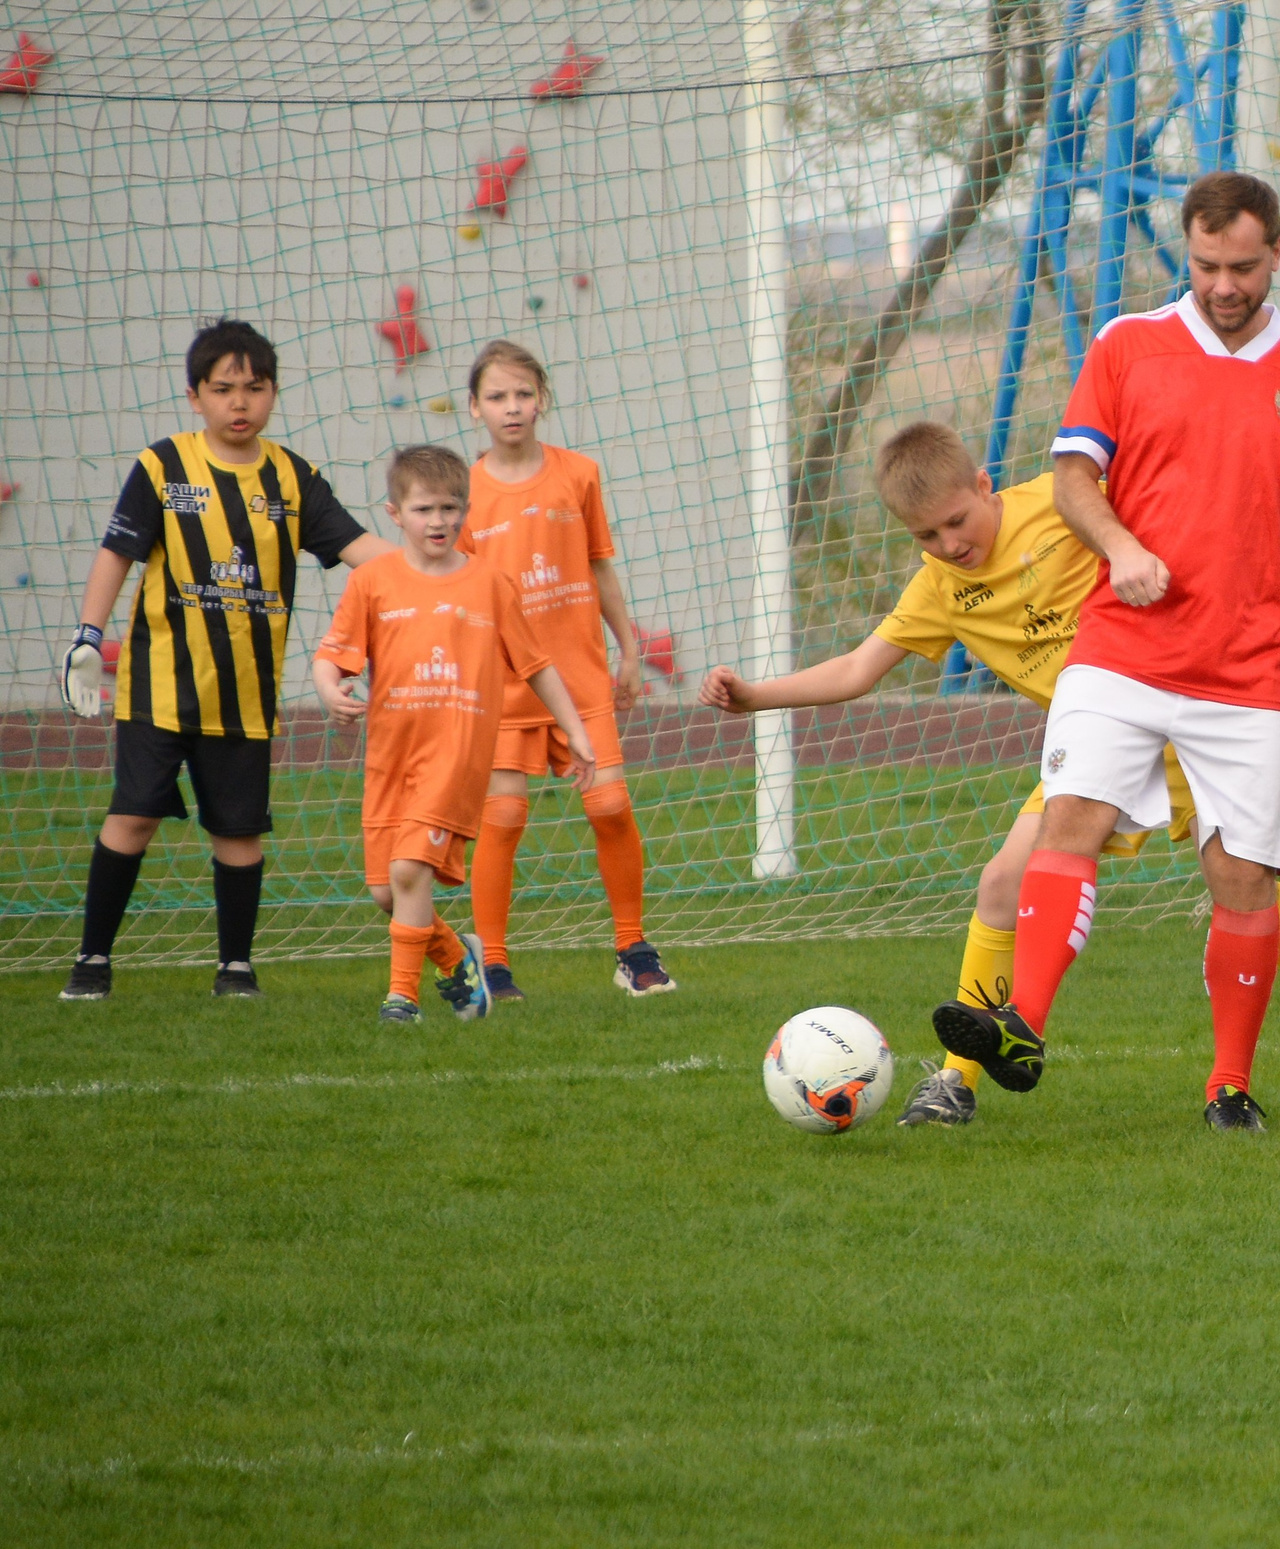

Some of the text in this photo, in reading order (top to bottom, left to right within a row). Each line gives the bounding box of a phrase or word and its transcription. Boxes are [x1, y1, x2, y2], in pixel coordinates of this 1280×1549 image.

[162, 483, 210, 497] НАШИ
[163, 498, 206, 512] ДЕТИ
[953, 582, 988, 602] НАШИ
[964, 589, 995, 611] ДЕТИ
[805, 1021, 854, 1055] DEMIX
